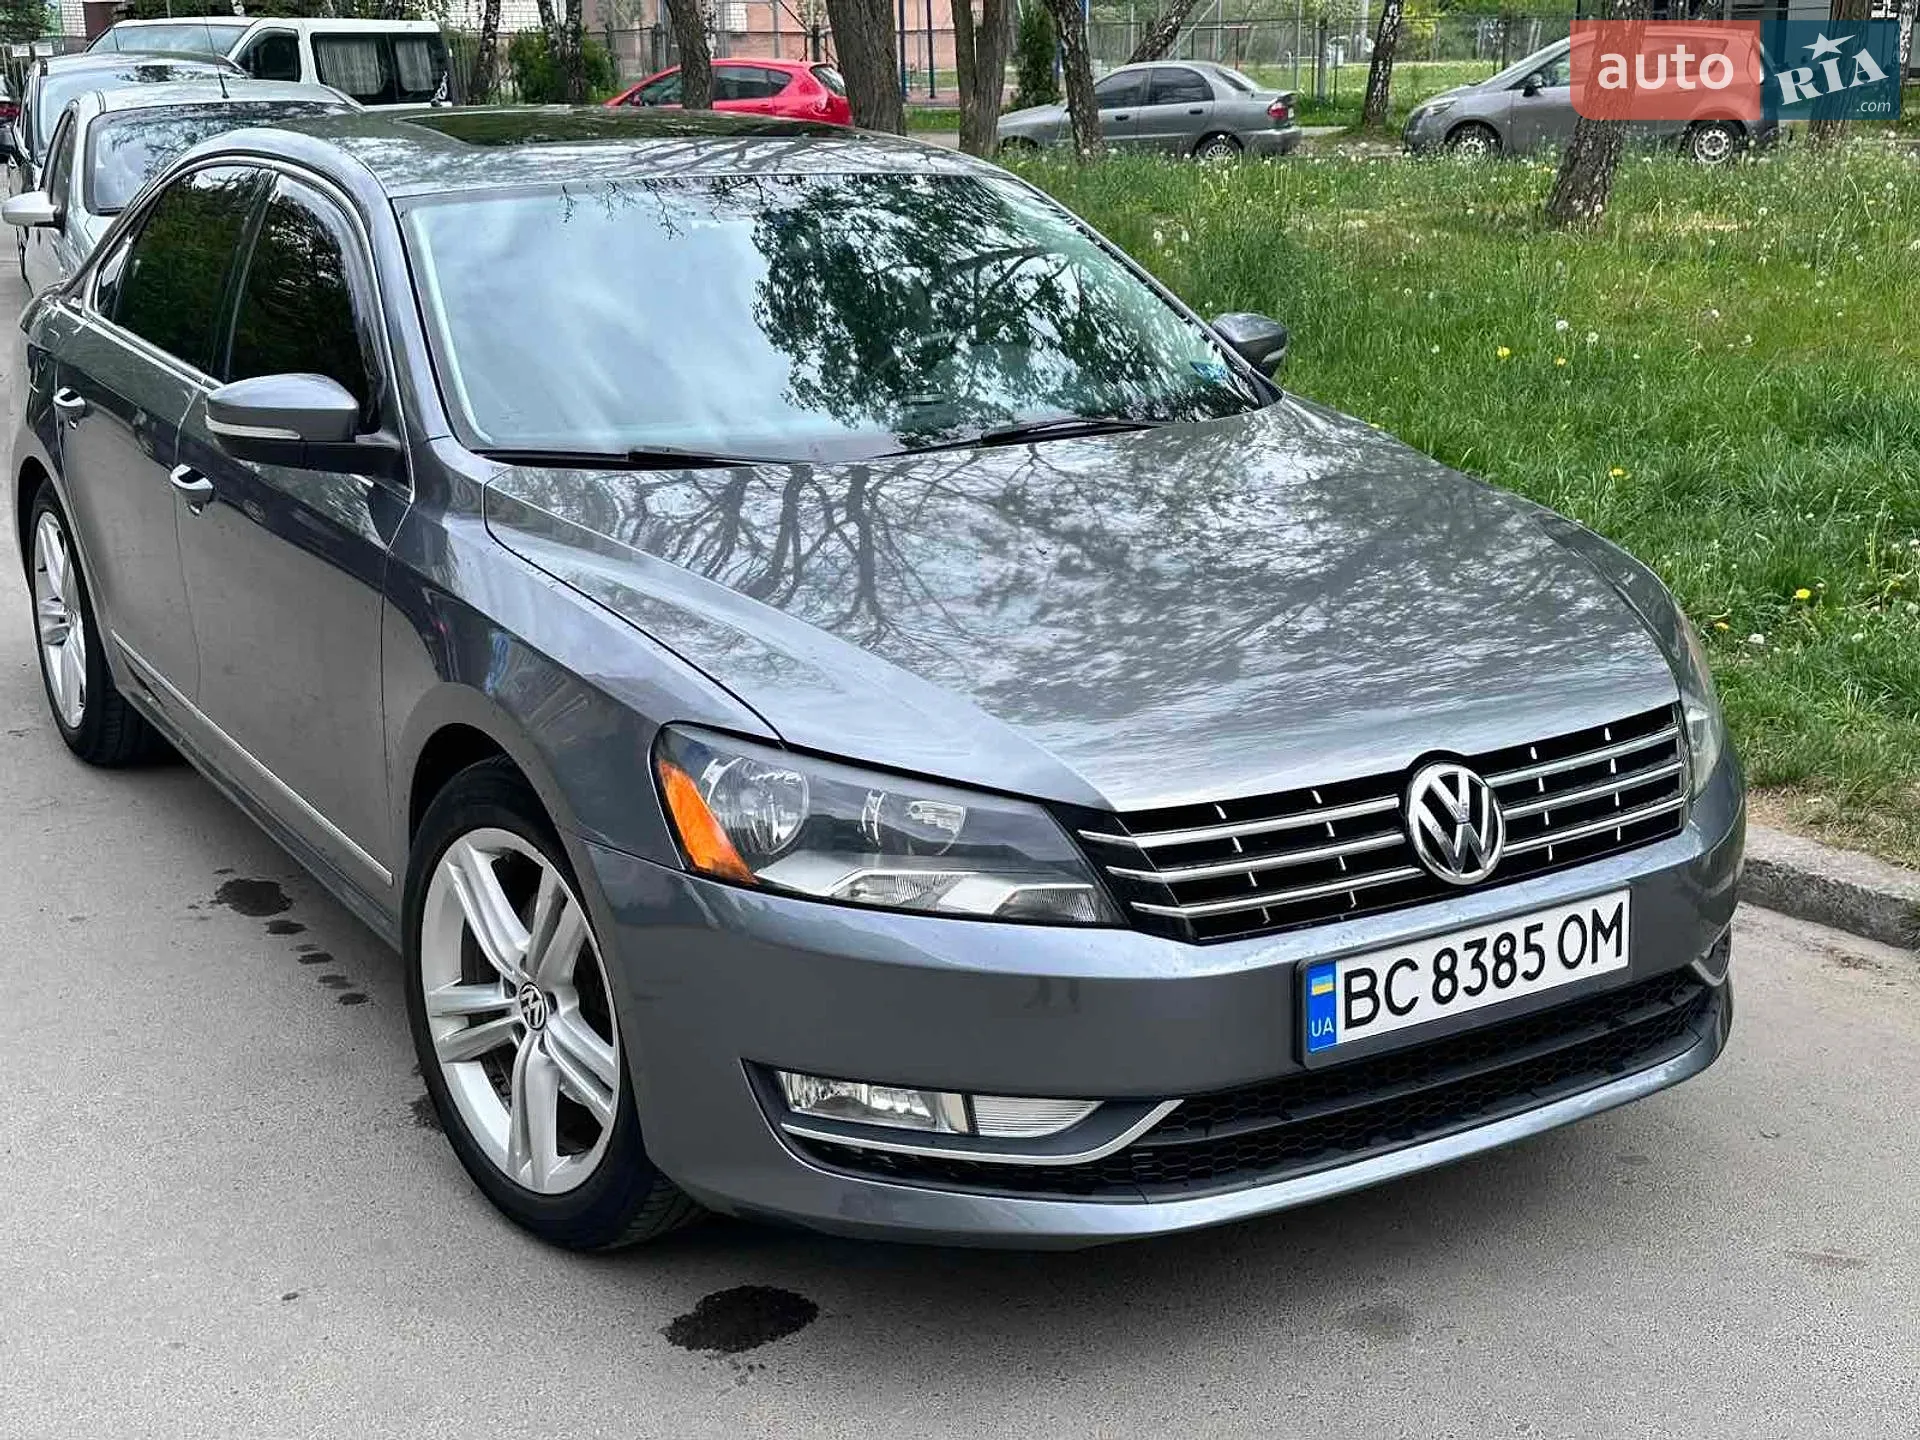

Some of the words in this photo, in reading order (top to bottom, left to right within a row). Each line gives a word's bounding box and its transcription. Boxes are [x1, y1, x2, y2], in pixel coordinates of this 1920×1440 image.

[1344, 958, 1420, 1030] BC
[1432, 922, 1546, 1006] 8385
[1557, 901, 1625, 970] OM
[1311, 1016, 1335, 1038] UA
